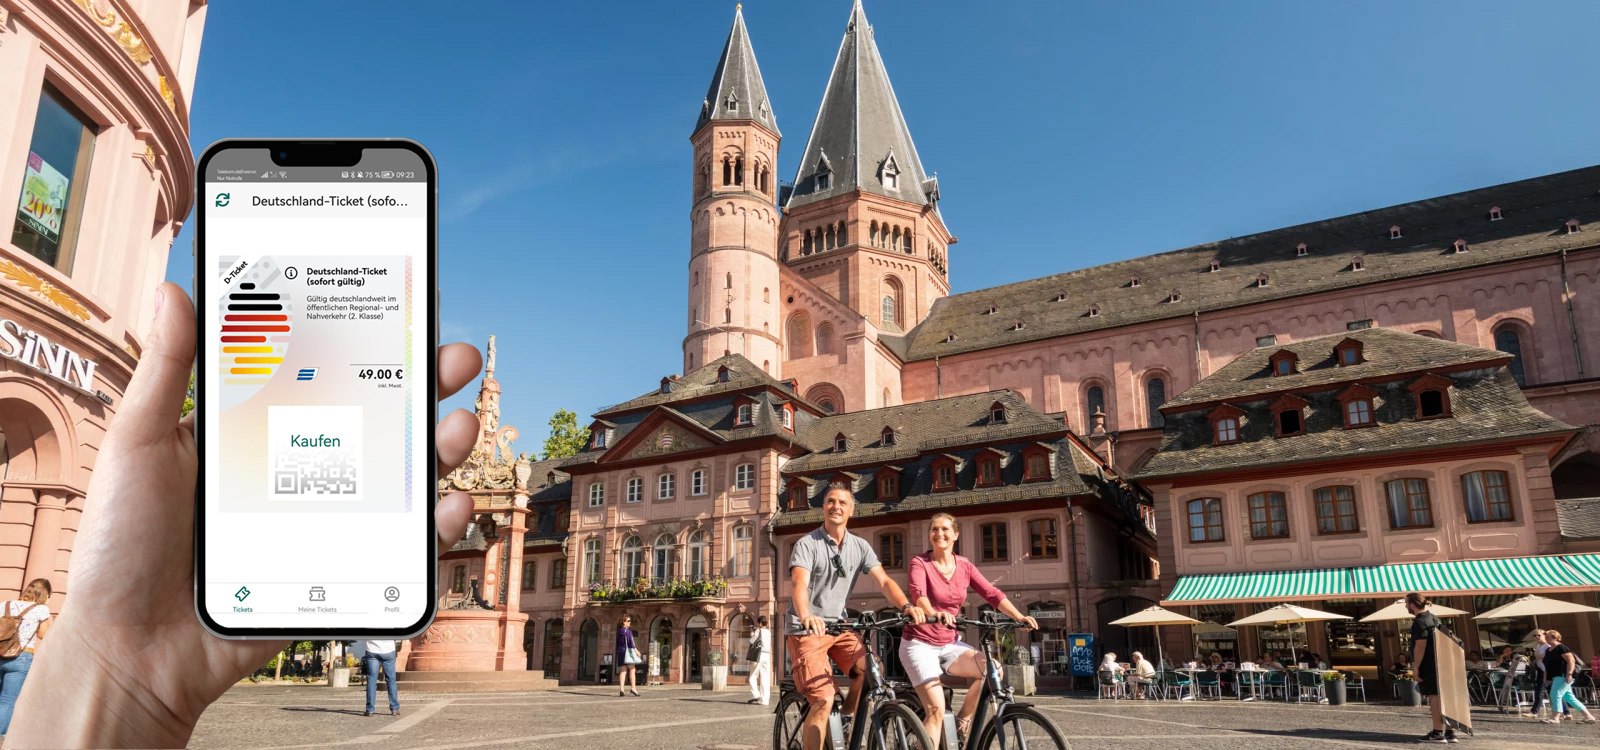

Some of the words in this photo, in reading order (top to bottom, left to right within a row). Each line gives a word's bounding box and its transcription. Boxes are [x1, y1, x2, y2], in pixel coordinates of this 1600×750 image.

[396, 171, 415, 179] 09:23
[252, 195, 364, 207] Deutschland-Ticket
[23, 190, 57, 230] 20%
[223, 260, 249, 285] D-Ticket
[306, 267, 388, 276] Deutschland-Ticket
[306, 277, 335, 288] (sofort
[337, 277, 365, 288] gültig)
[306, 295, 328, 303] Gültig
[306, 303, 348, 311] öffentlichen
[349, 303, 384, 312] Regional-
[385, 303, 399, 311] und
[306, 312, 347, 320] Nahverkehr
[348, 312, 358, 321] (2.
[359, 312, 384, 321] Klasse)
[359, 369, 392, 380] 49.00
[395, 369, 403, 380] €
[291, 434, 341, 448] Kaufen
